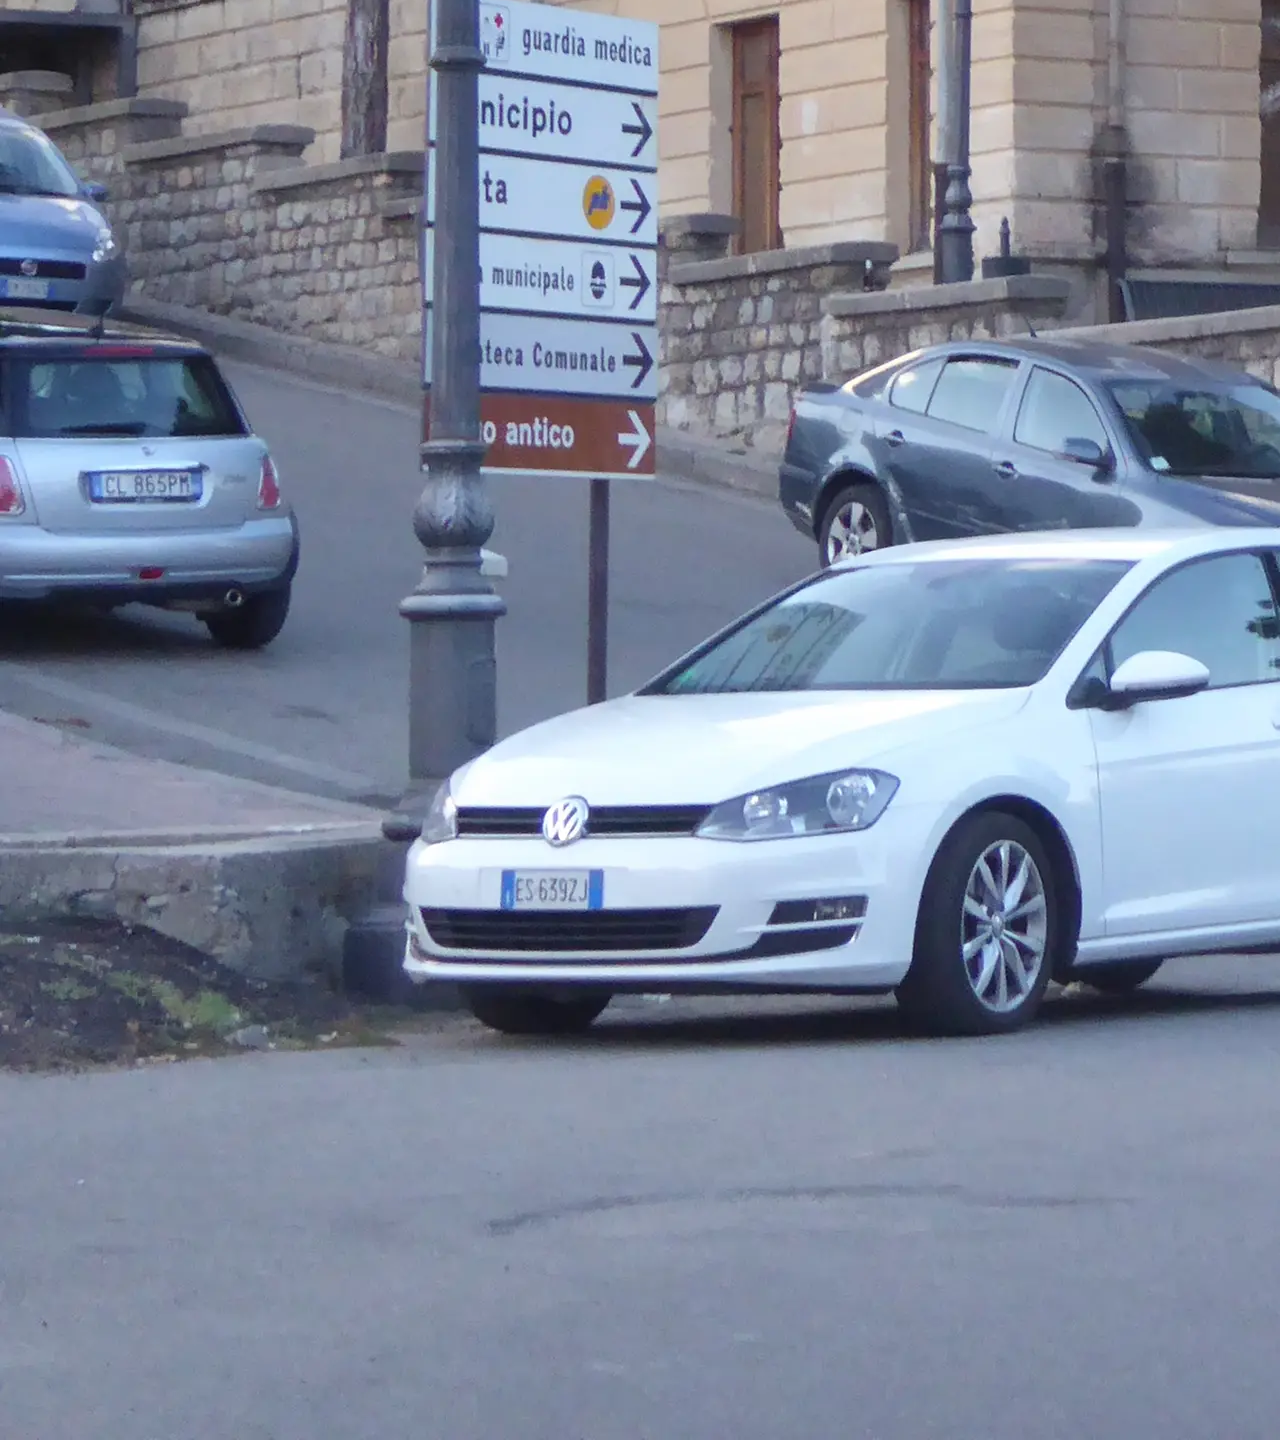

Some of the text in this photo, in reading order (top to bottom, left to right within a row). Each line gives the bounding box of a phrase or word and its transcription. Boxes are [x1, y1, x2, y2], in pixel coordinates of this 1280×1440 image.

[522, 26, 652, 67] guardia medica
[480, 92, 573, 138] nicipio
[491, 262, 575, 297] municipale
[532, 341, 616, 373] Comunale
[505, 416, 575, 449] antico
[104, 474, 190, 497] CL 865PM
